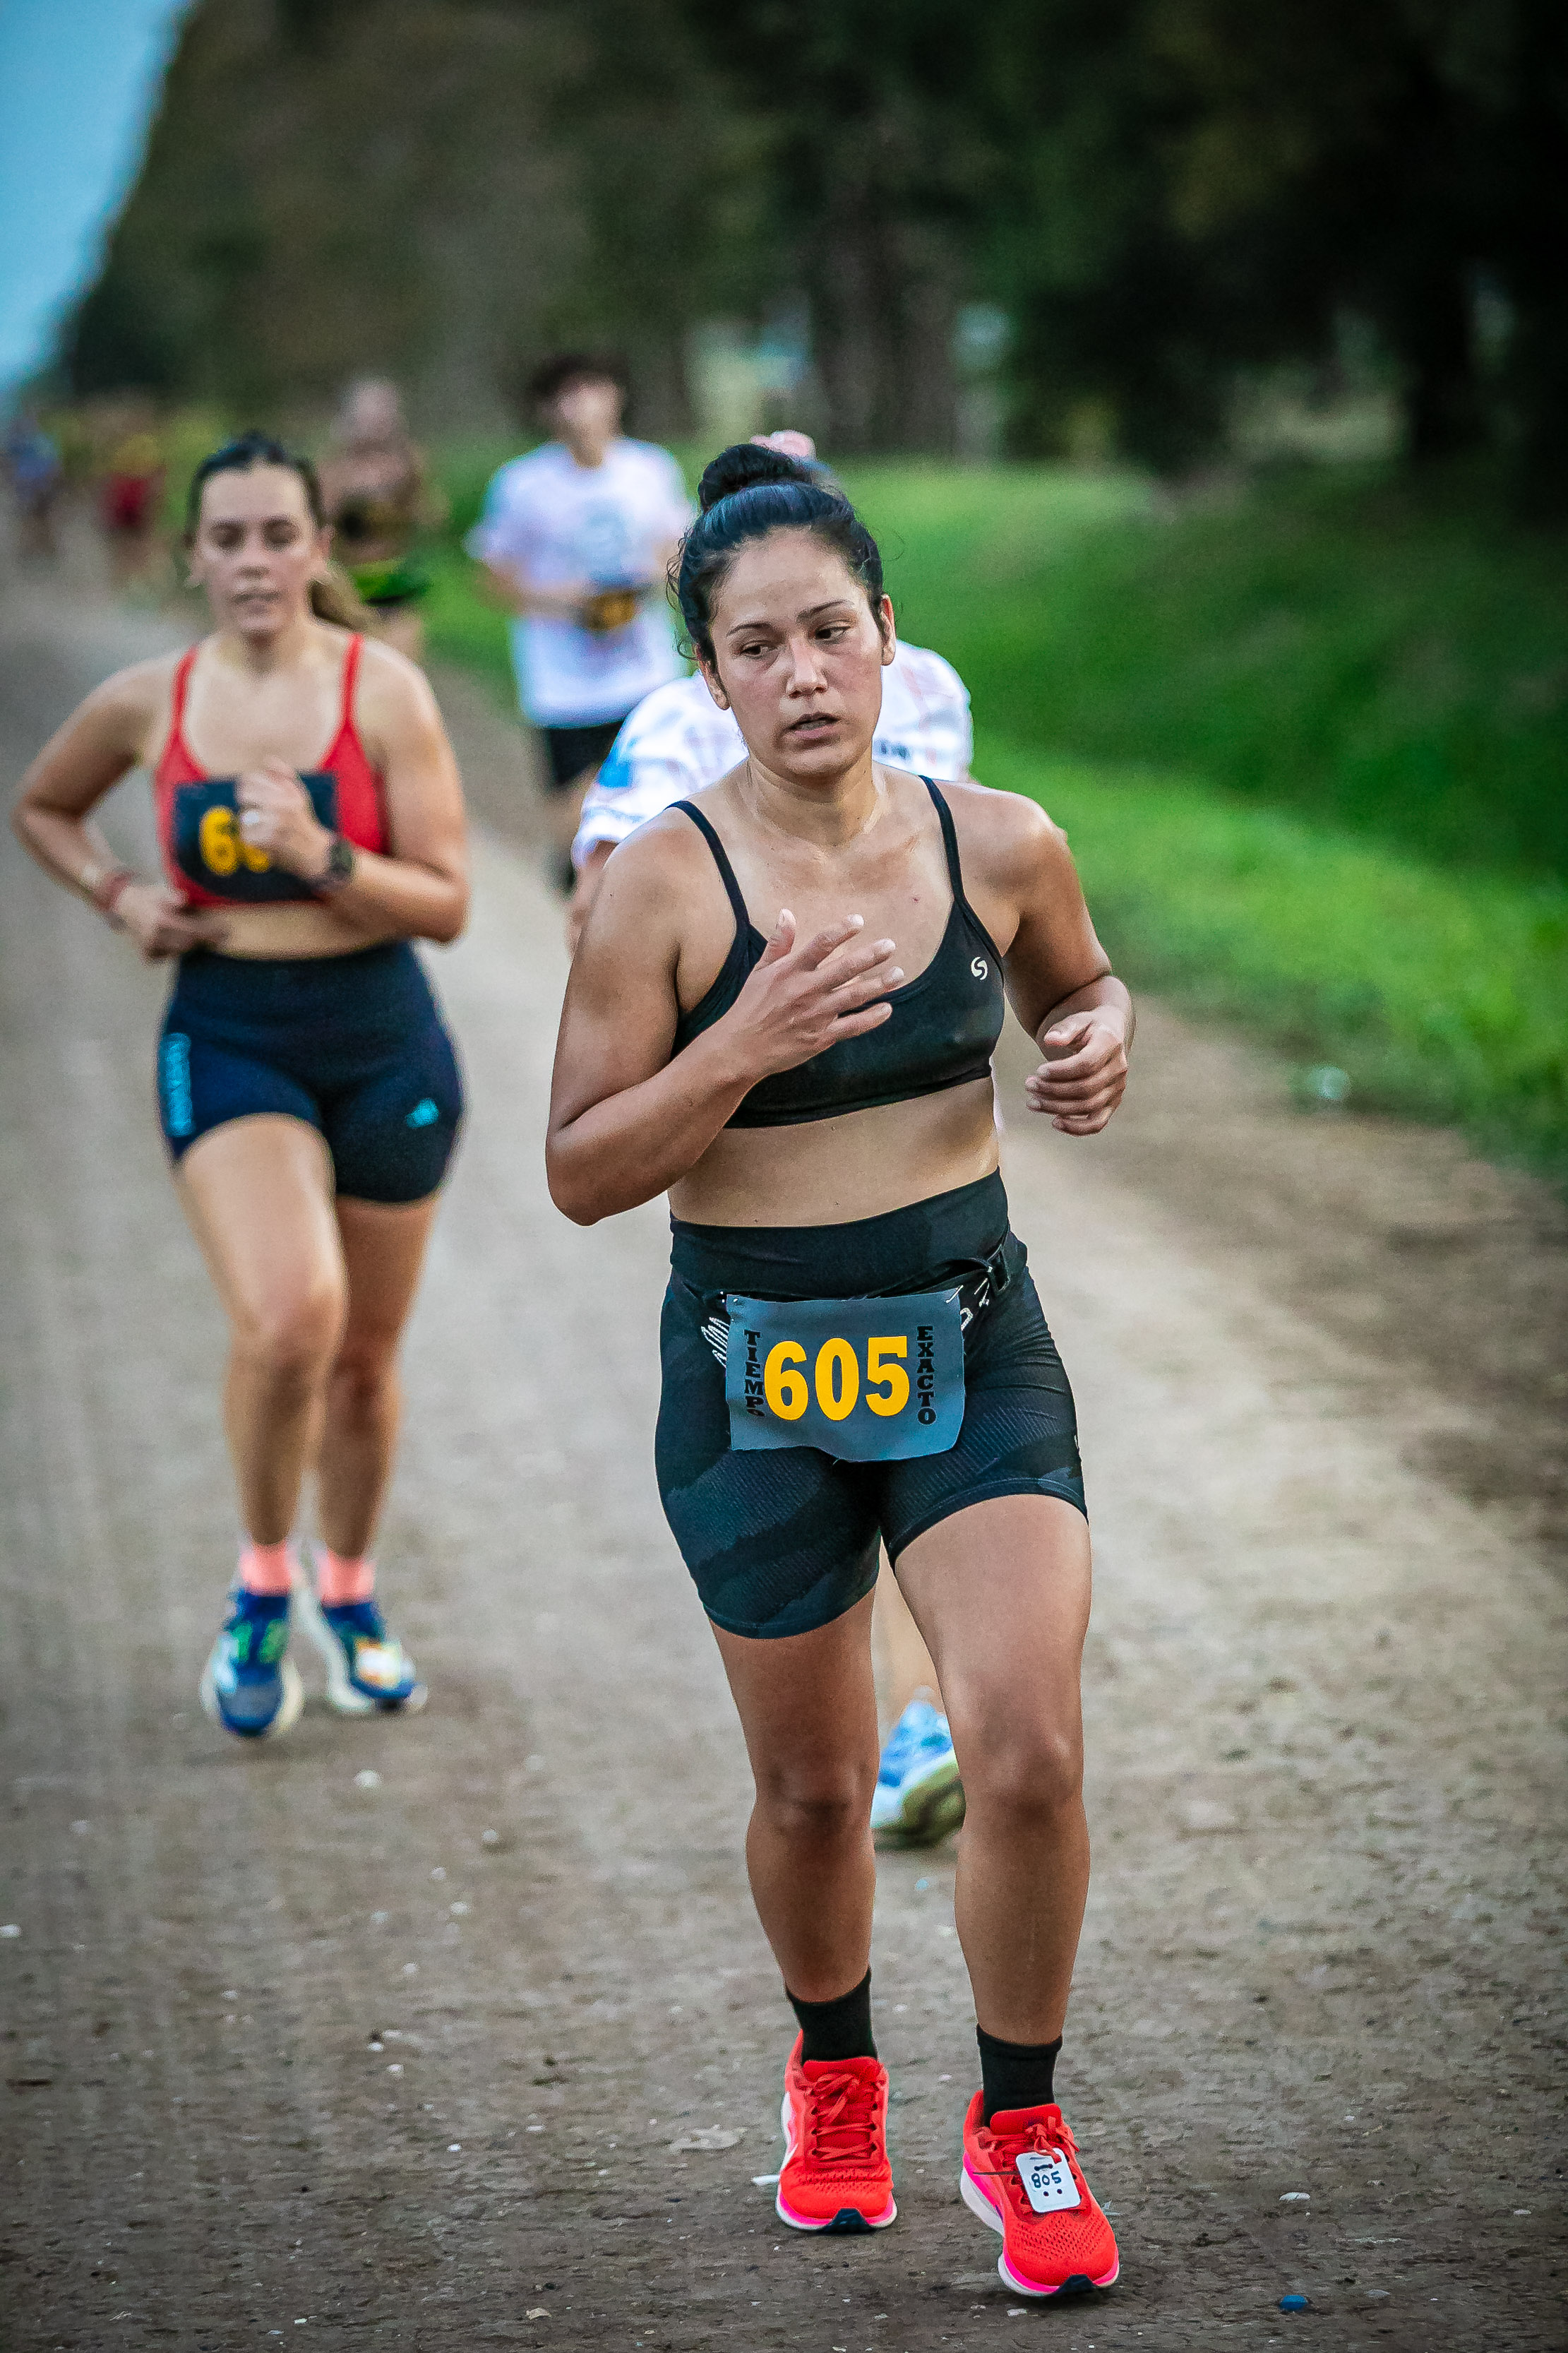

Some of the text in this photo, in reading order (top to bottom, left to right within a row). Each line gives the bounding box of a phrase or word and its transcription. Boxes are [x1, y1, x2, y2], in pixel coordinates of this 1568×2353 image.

[743, 1329, 765, 1417] TIEMPO
[764, 1335, 909, 1421] 605
[917, 1325, 937, 1425] EXACTO
